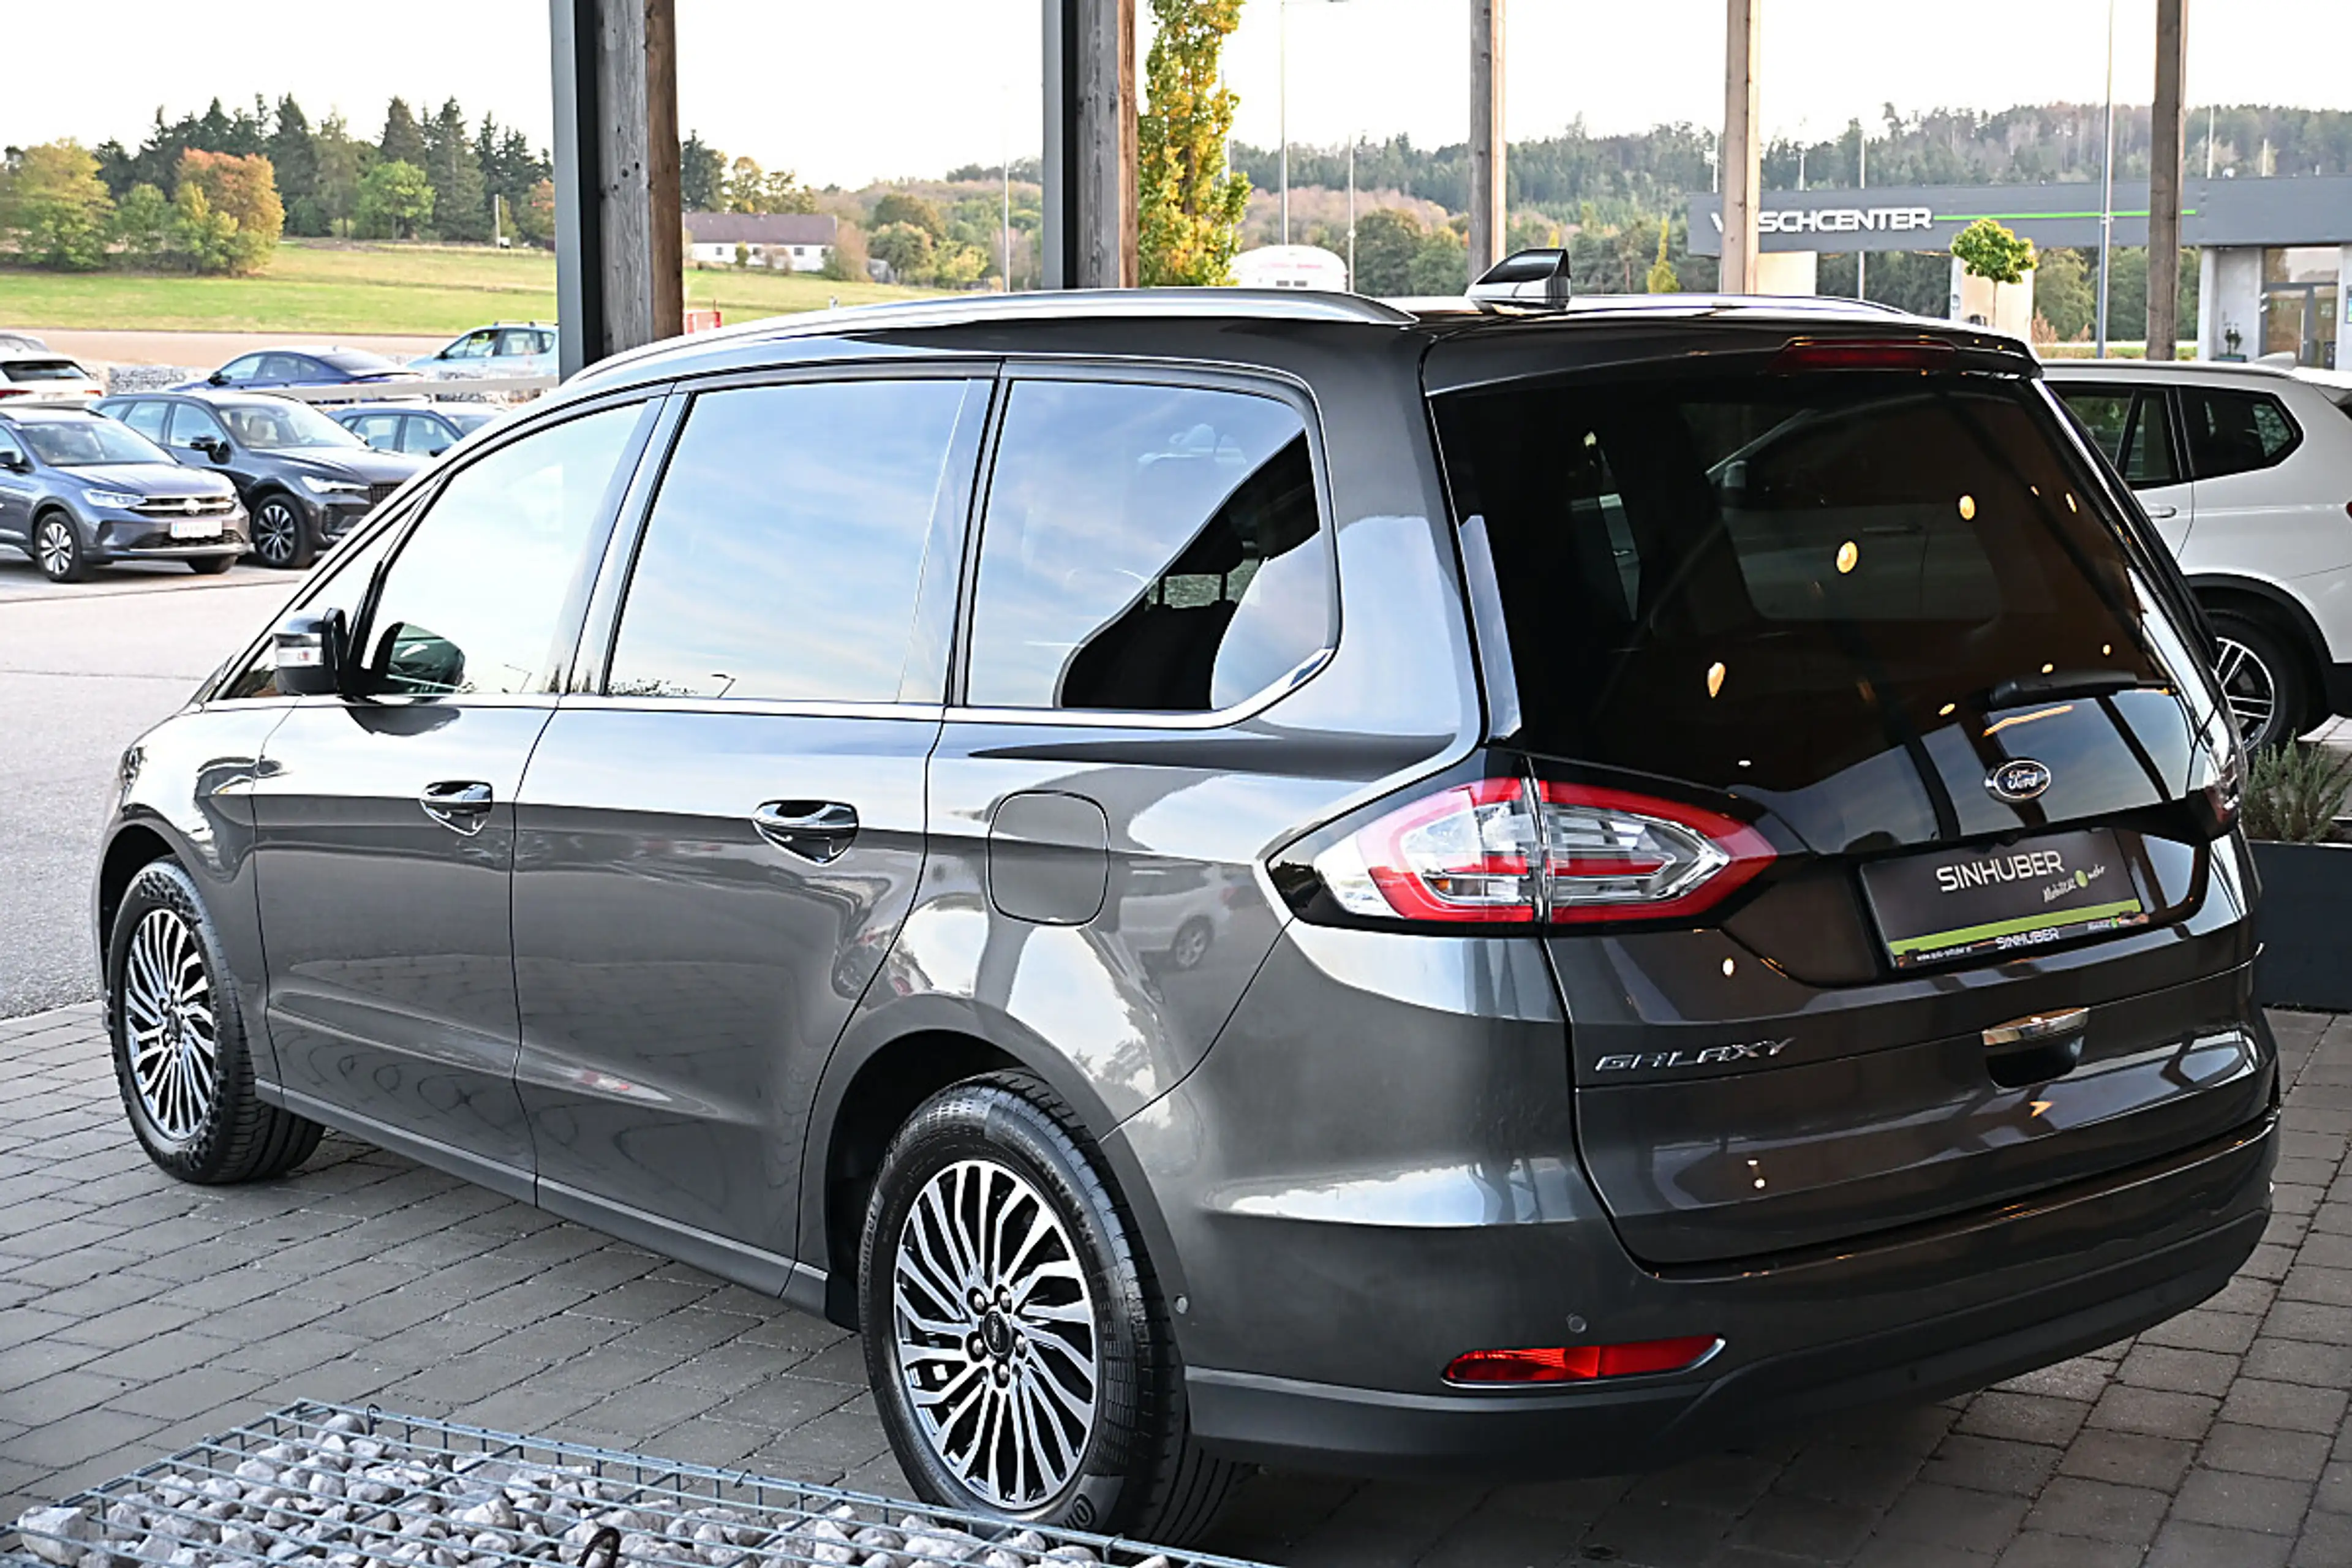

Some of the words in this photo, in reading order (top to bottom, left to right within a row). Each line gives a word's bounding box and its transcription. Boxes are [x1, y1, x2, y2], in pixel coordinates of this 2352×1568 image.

[1711, 208, 1933, 233] SCHCENTER
[1936, 850, 2065, 892] SINHUBER
[1995, 927, 2060, 950] SINHUBER
[1594, 1036, 1796, 1071] GALAXY
